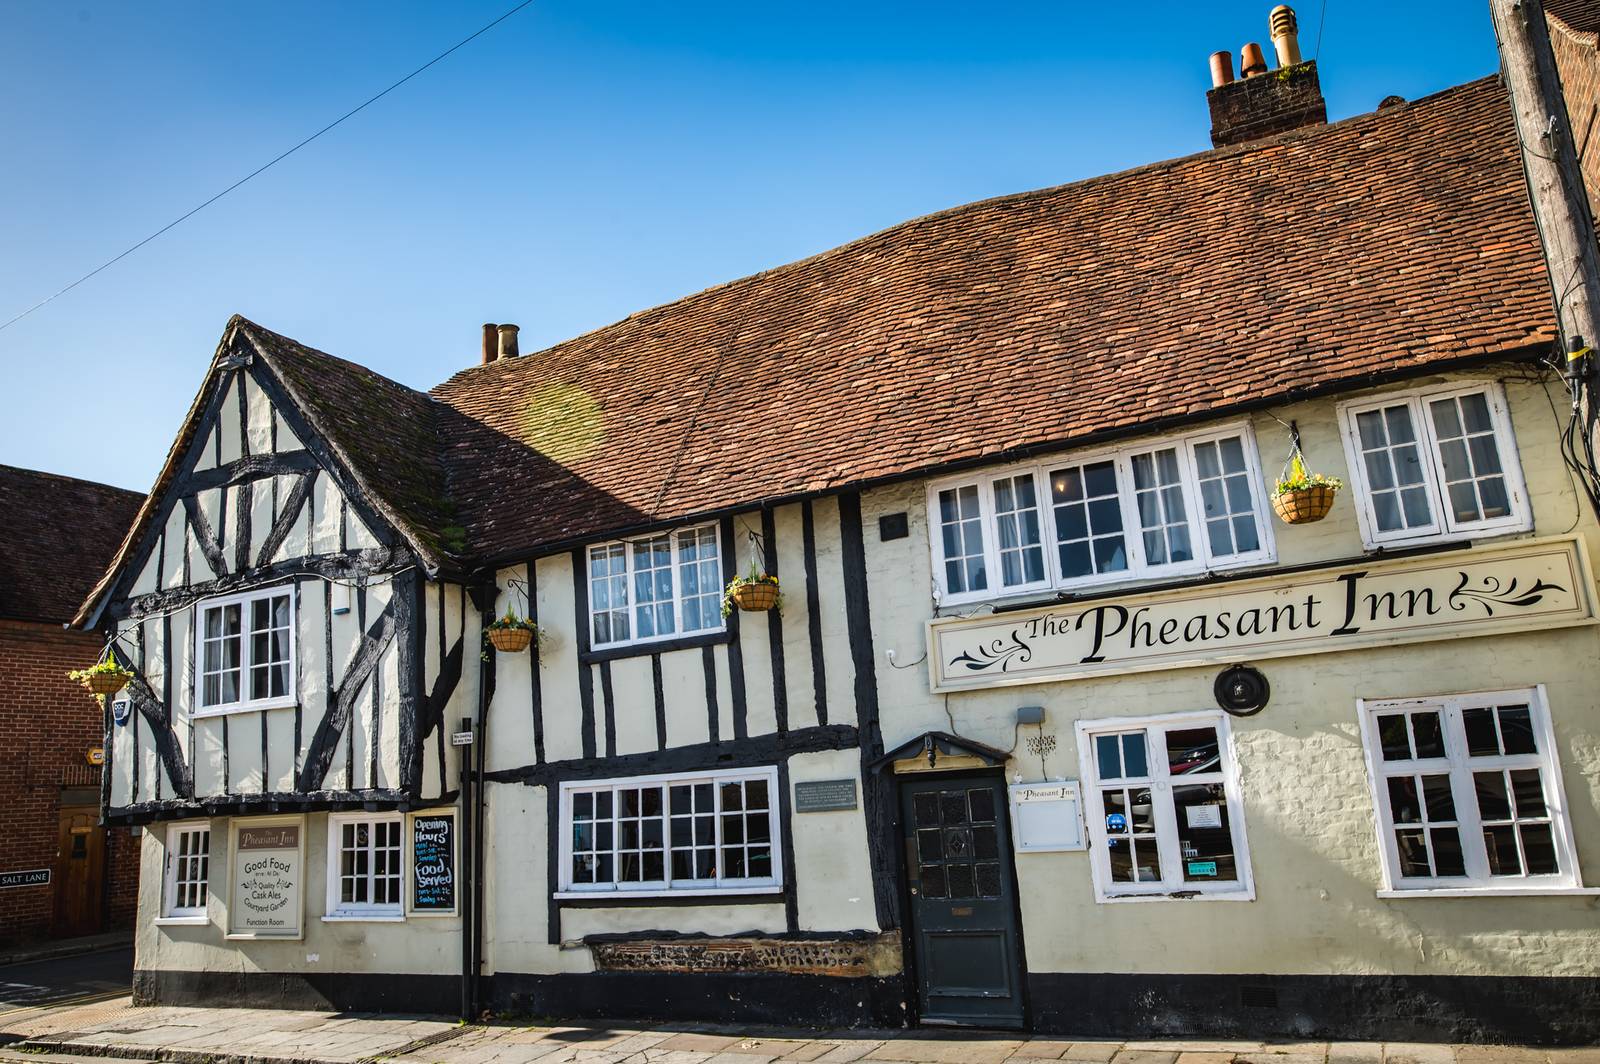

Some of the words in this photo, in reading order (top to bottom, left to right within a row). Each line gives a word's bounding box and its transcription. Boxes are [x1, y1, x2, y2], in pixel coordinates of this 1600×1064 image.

[1025, 613, 1069, 638] The
[1075, 594, 1322, 663] Pheasant
[1330, 571, 1441, 635] Inn
[1023, 789, 1059, 800] Pheasant
[1060, 788, 1074, 798] Inn
[415, 819, 448, 834] Opening
[242, 832, 278, 847] Pheasant
[280, 831, 294, 846] Inn
[415, 832, 446, 844] Hours
[244, 858, 267, 874] Good
[270, 857, 290, 873] Food
[415, 858, 444, 880] Food
[2, 875, 22, 885] SALT
[25, 873, 47, 882] LANE
[418, 867, 452, 888] Served
[252, 890, 267, 899] Cask
[268, 890, 281, 899] Ales
[244, 898, 269, 913] Courtyard
[270, 897, 288, 911] Garden
[246, 918, 268, 926] Function
[269, 918, 285, 926] Room
